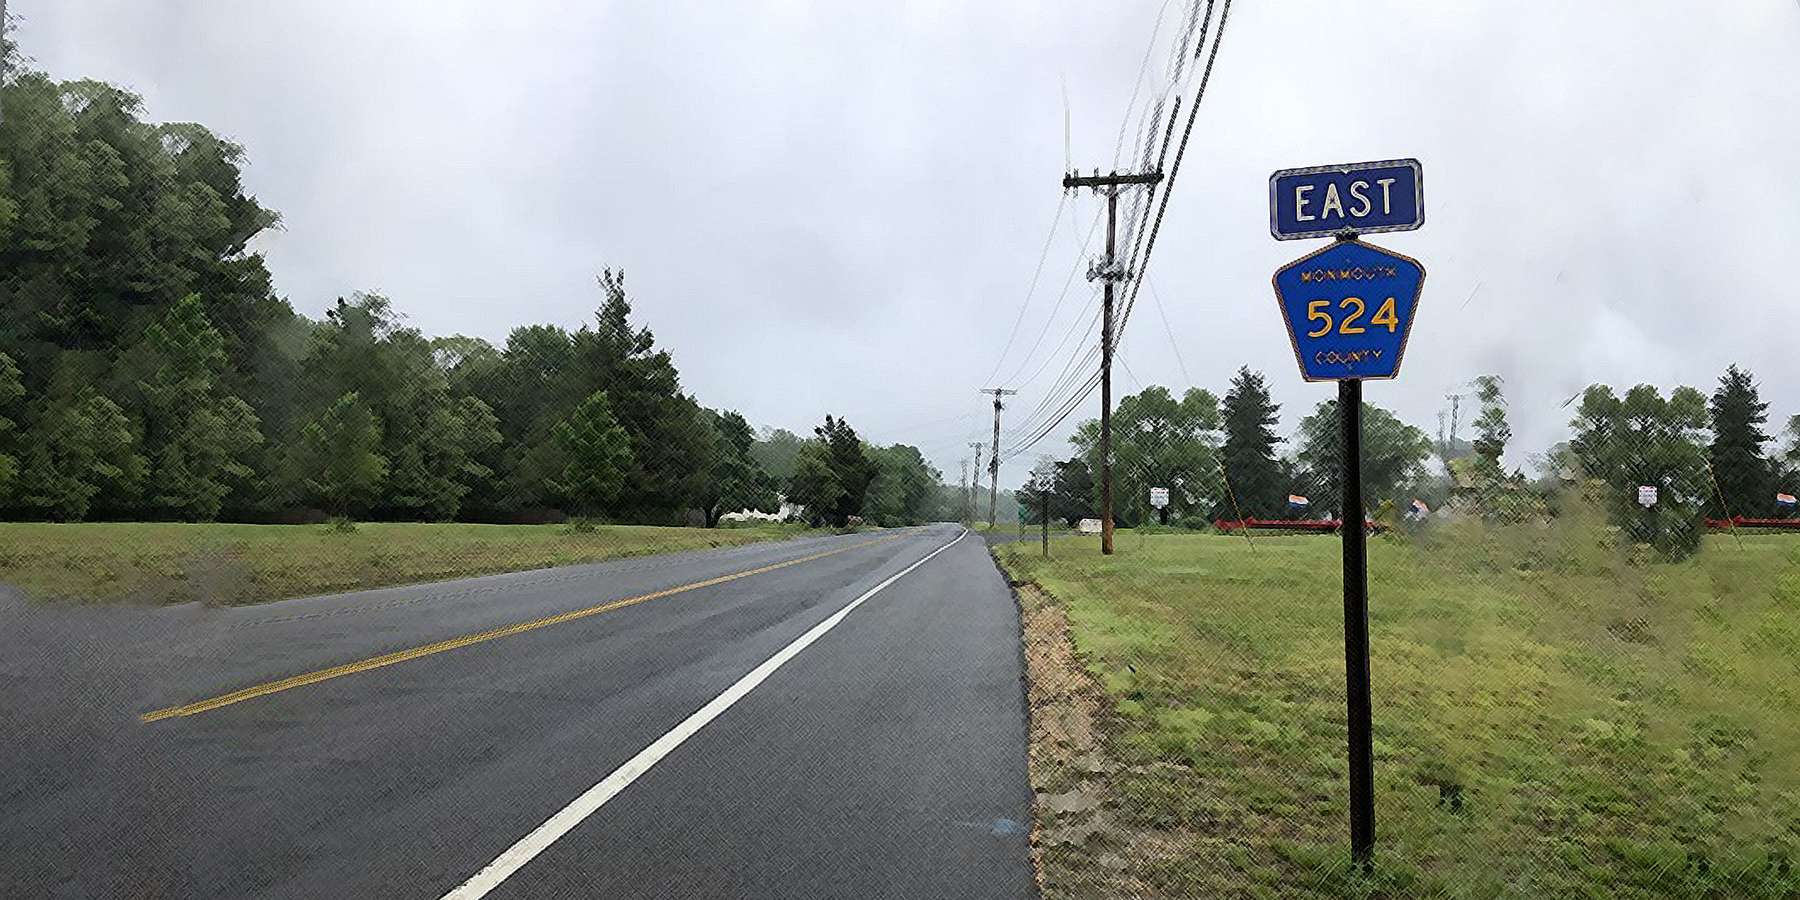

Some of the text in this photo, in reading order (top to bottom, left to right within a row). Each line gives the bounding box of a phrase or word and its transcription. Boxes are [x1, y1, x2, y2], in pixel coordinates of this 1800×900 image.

[1295, 178, 1397, 222] EAST
[1307, 296, 1399, 338] 524
[1315, 349, 1383, 365] COUNTY
